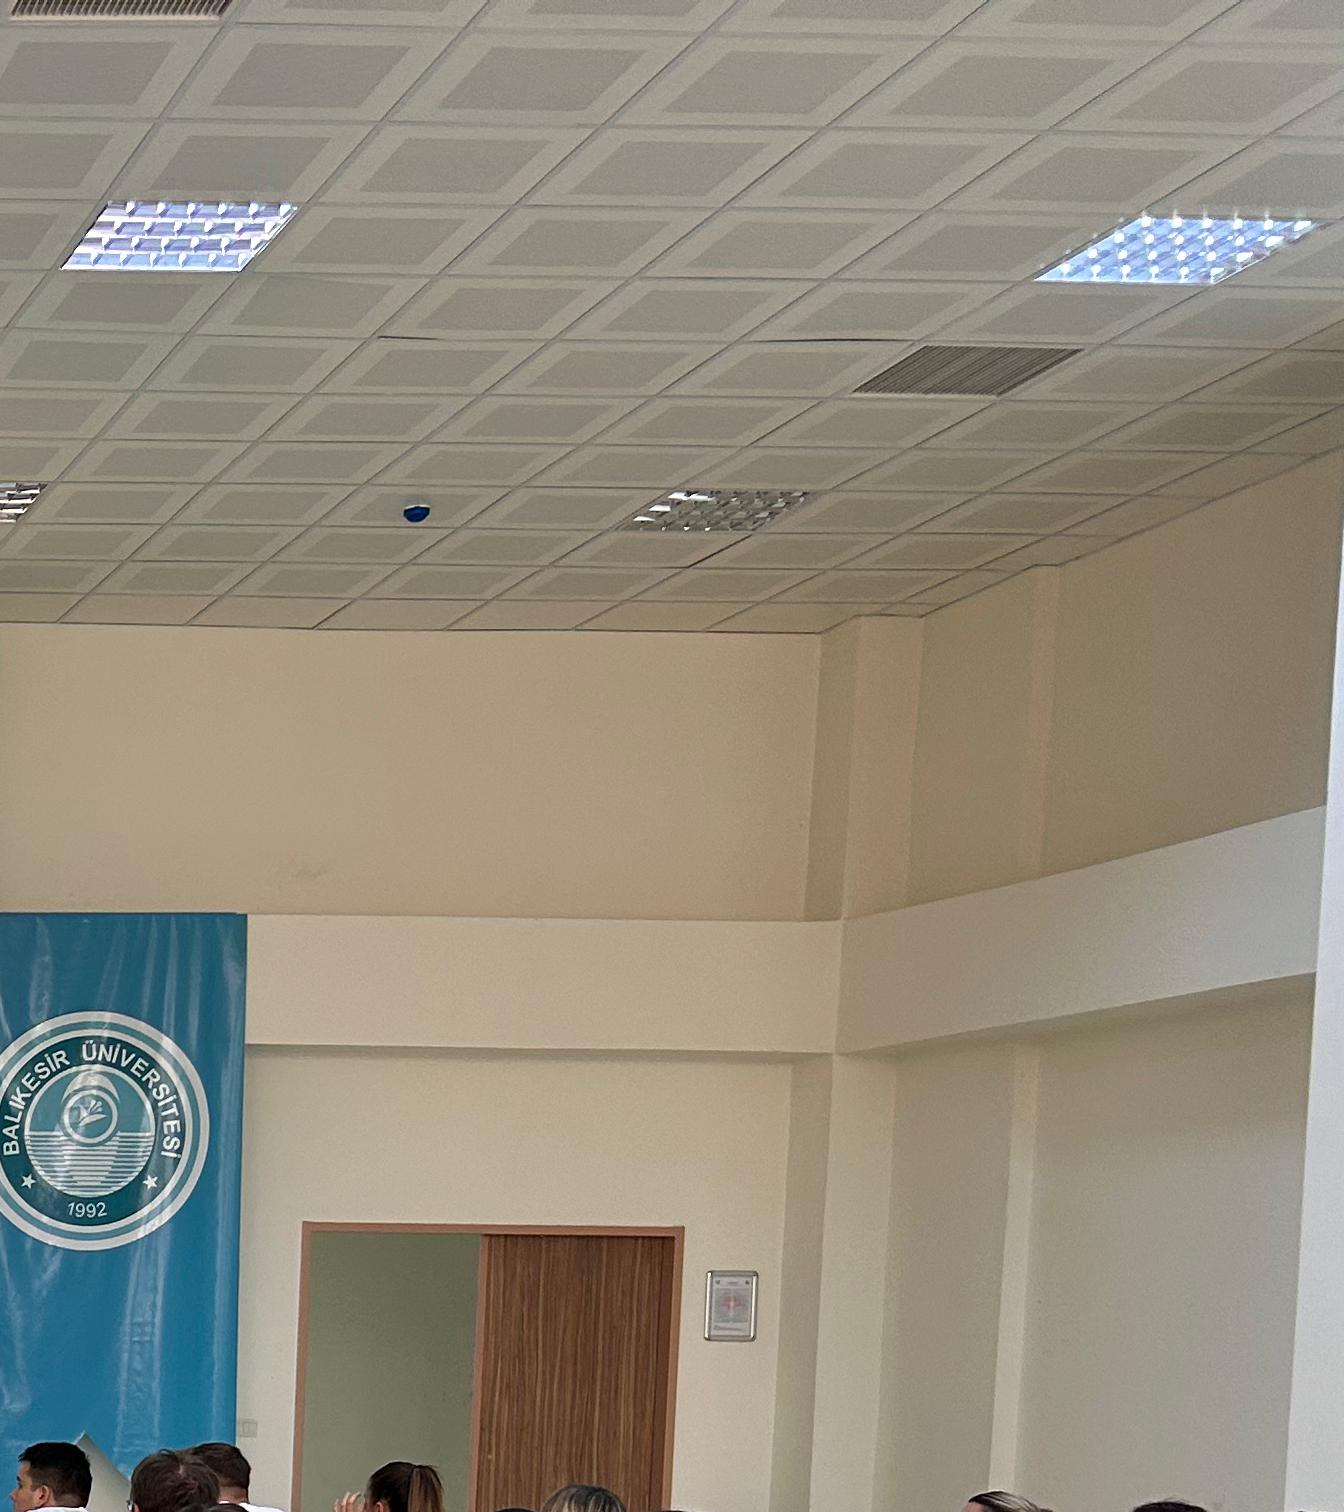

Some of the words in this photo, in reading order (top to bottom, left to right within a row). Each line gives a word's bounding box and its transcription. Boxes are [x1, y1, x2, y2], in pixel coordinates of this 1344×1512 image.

[2, 1049, 71, 1156] BALIKESİR
[81, 1039, 182, 1159] ÜNİVERSİTESİ
[67, 1201, 108, 1218] 1992
